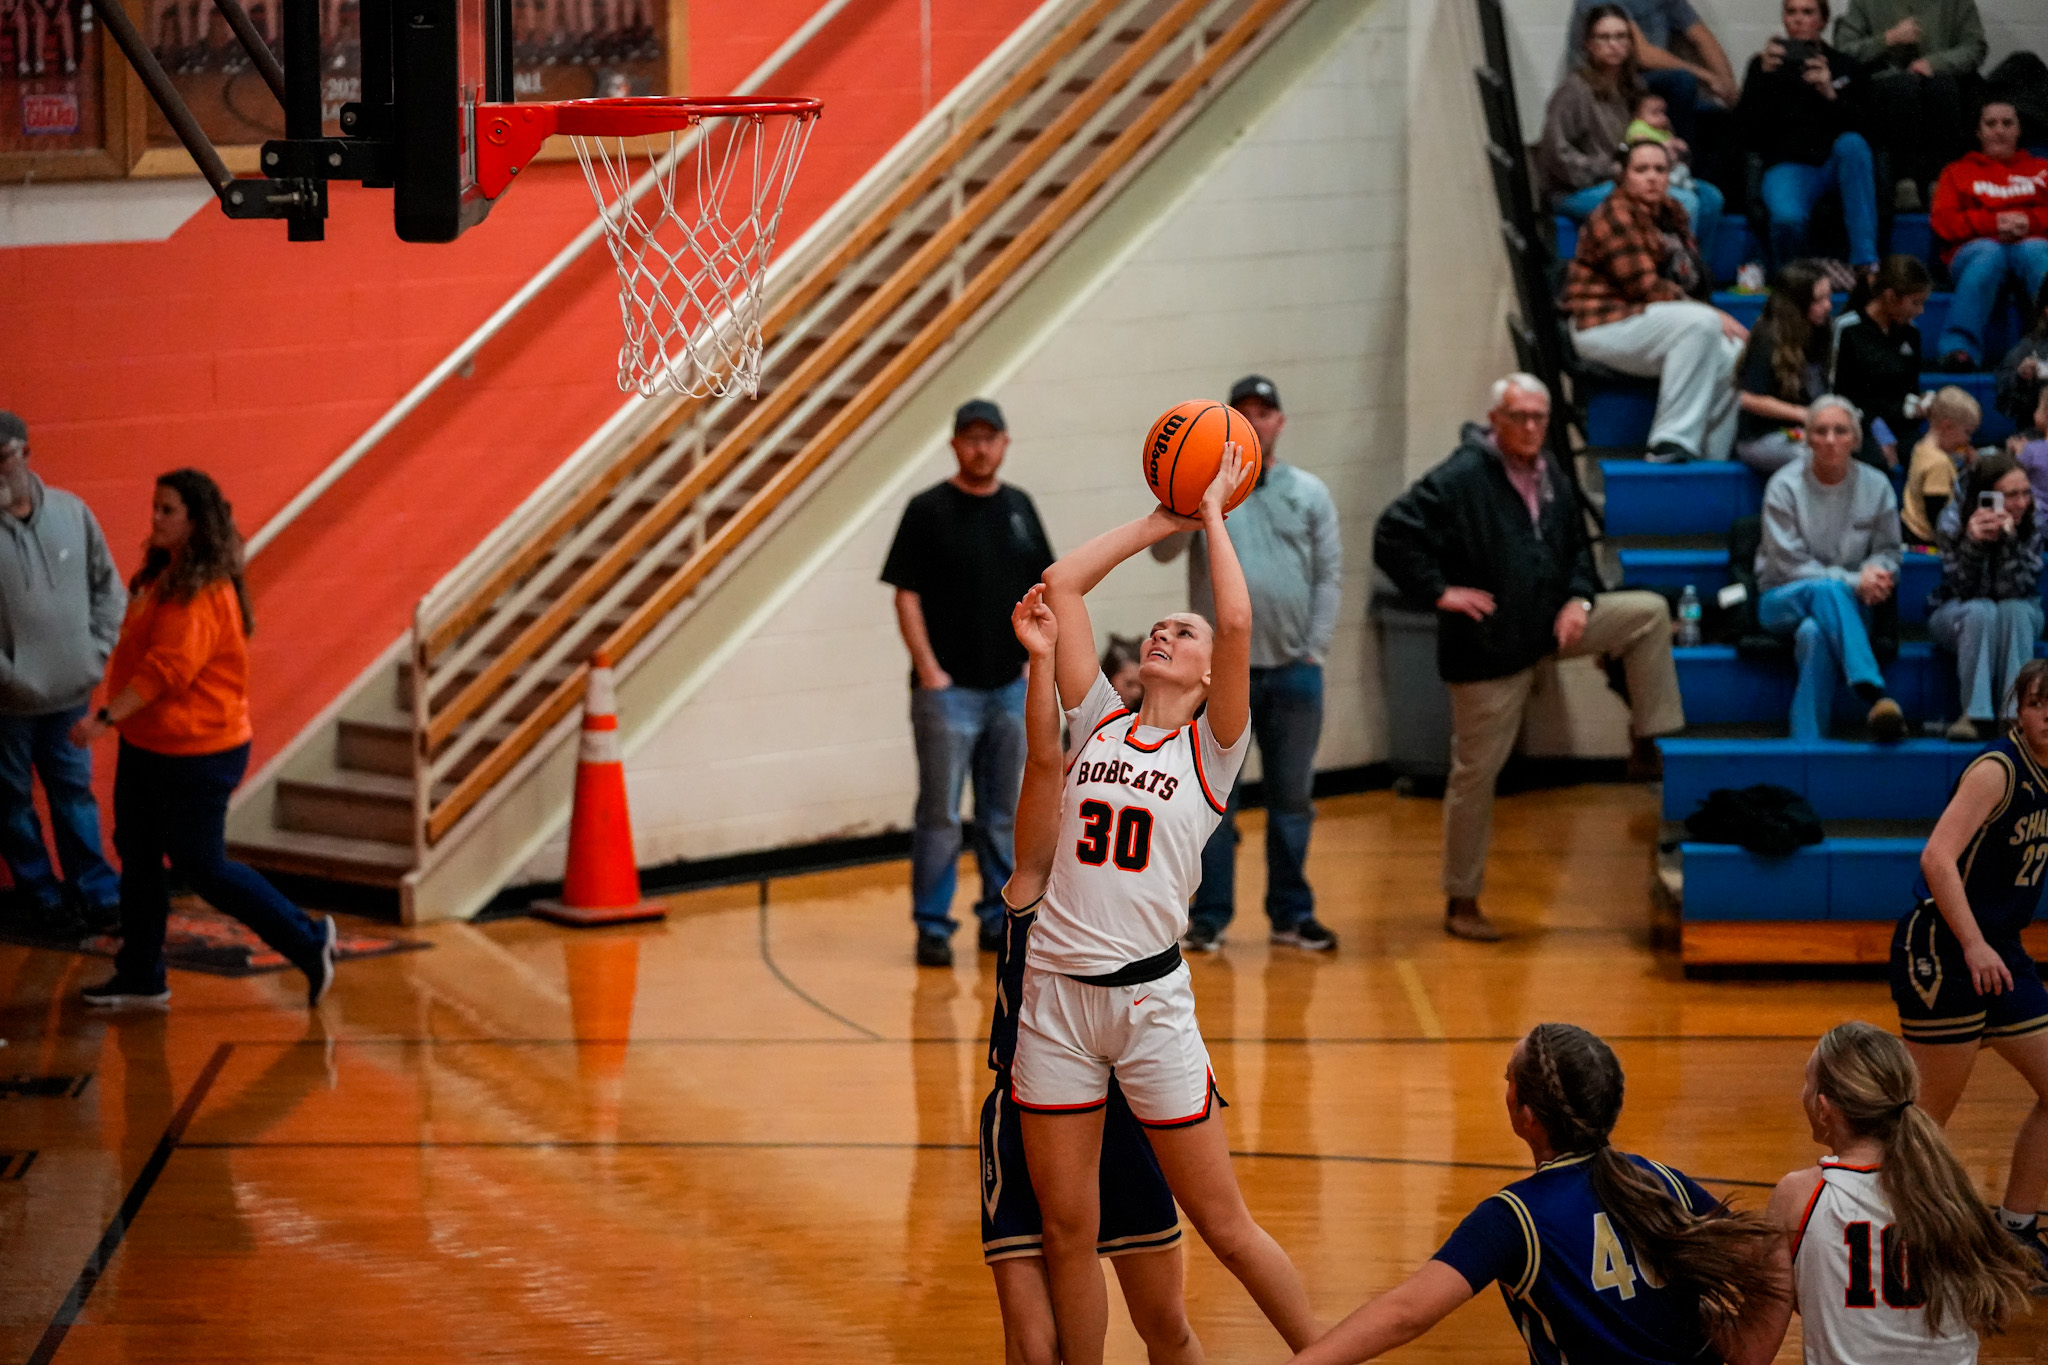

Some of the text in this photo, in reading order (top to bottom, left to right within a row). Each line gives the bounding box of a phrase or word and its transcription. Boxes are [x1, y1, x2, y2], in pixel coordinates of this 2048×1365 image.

[1150, 414, 1188, 487] Wilson
[1077, 759, 1179, 801] BOBCATS
[1076, 797, 1154, 873] 30
[2009, 807, 2048, 846] SHA
[1843, 1220, 1928, 1310] 10
